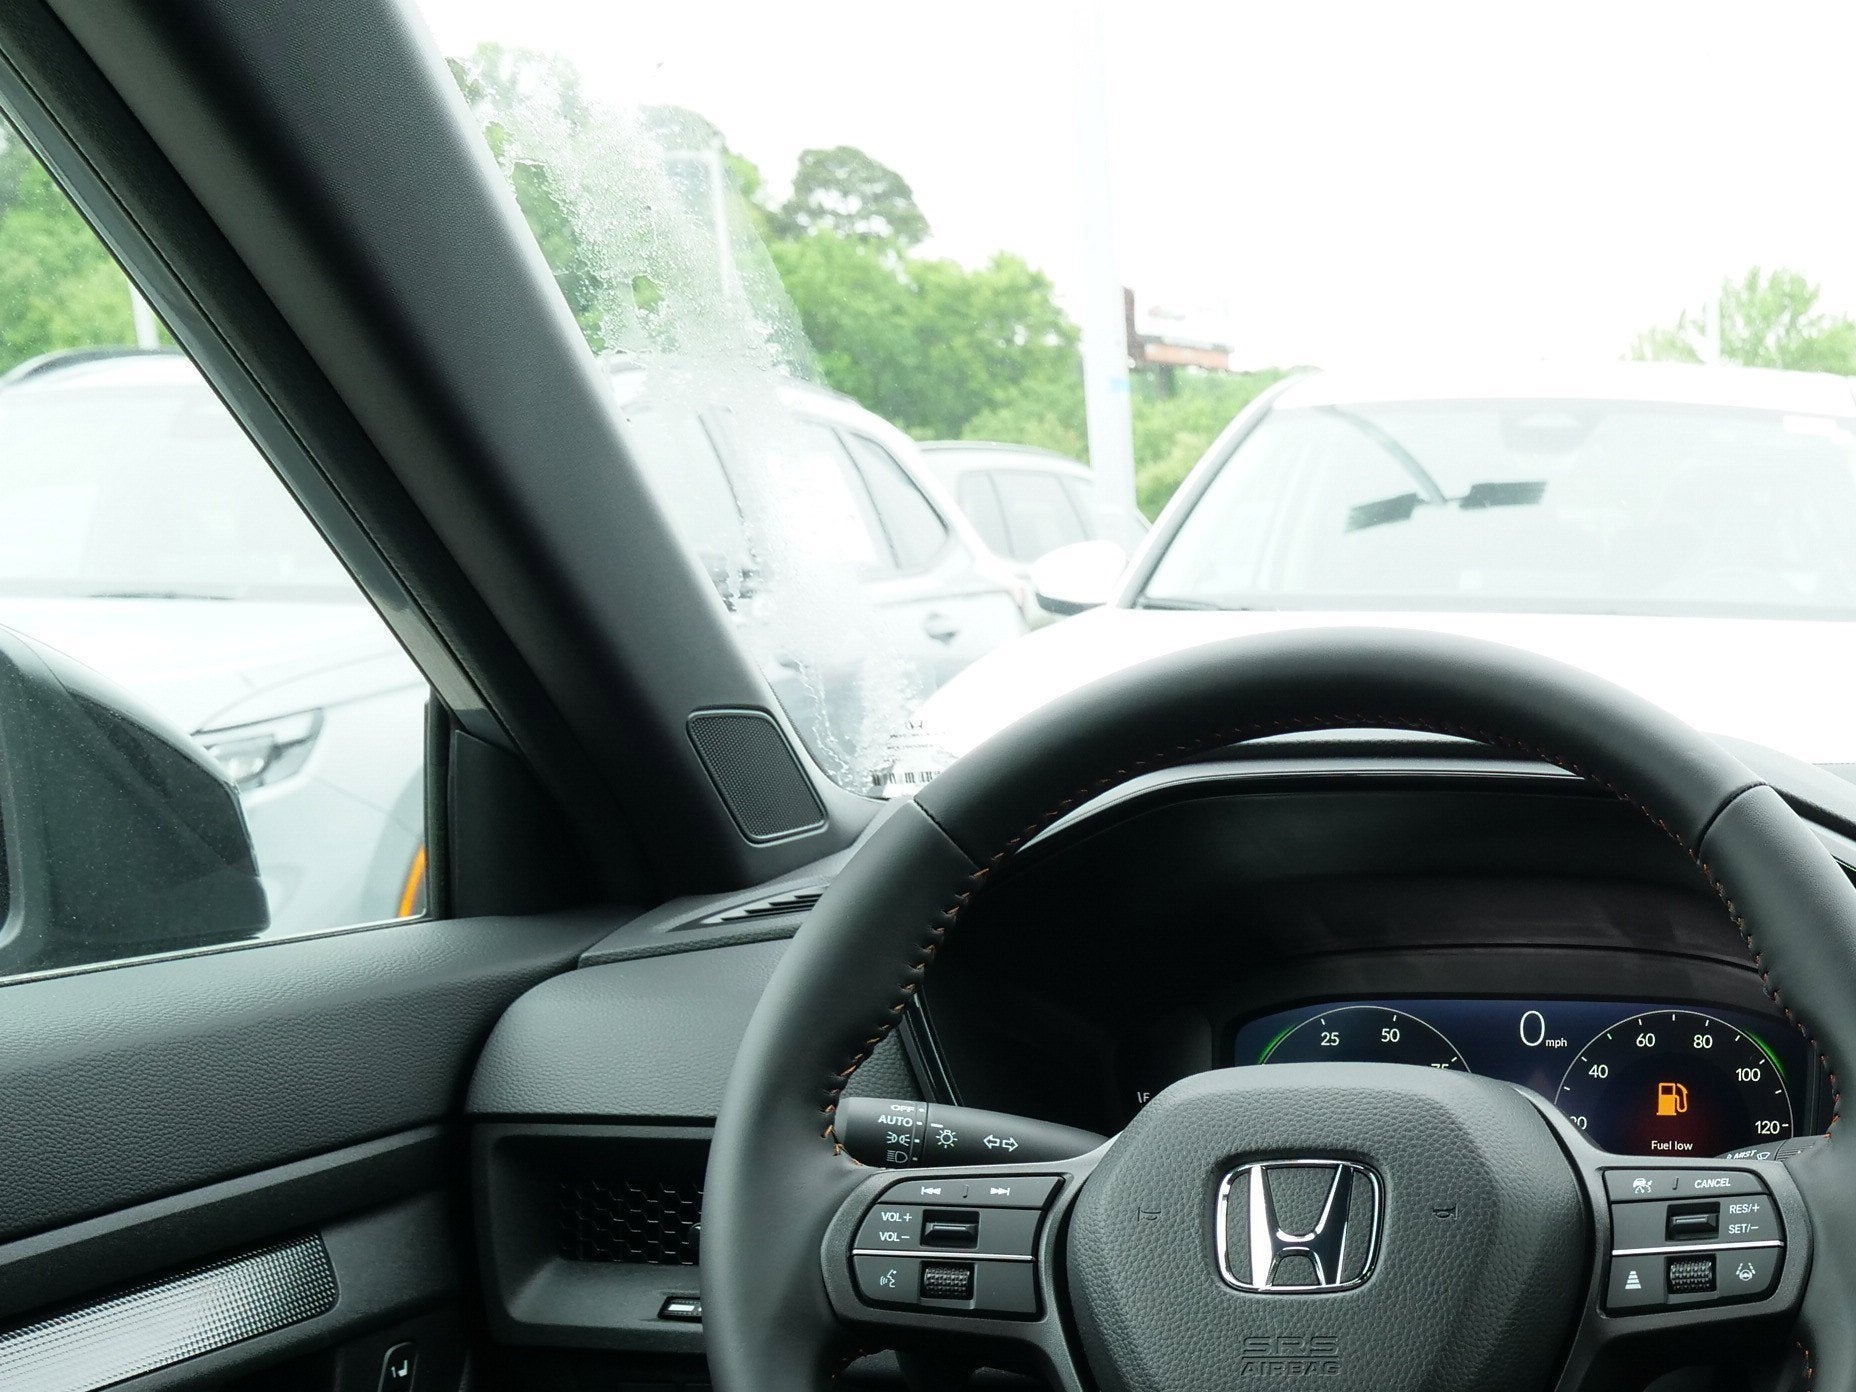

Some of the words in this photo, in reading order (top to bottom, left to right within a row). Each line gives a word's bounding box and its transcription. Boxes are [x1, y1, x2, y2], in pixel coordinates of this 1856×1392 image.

[1381, 1028, 1401, 1043] 50
[1519, 1011, 1546, 1046] 0
[1545, 1038, 1568, 1048] mph
[1320, 1032, 1340, 1046] 25
[1636, 1033, 1656, 1048] 60
[1693, 1034, 1714, 1049] 80
[1589, 1065, 1609, 1079] 40
[1735, 1068, 1761, 1082] 100
[890, 1104, 915, 1112] OFF
[877, 1114, 914, 1128] AUTO
[1755, 1120, 1781, 1135] 120
[1651, 1141, 1675, 1151] Fuel
[1677, 1141, 1694, 1151] low
[1694, 1178, 1732, 1189] CANCEL
[1729, 1204, 1760, 1215] RES/+
[1242, 1336, 1340, 1355] SRS
[1240, 1361, 1343, 1377] AIRBAG
